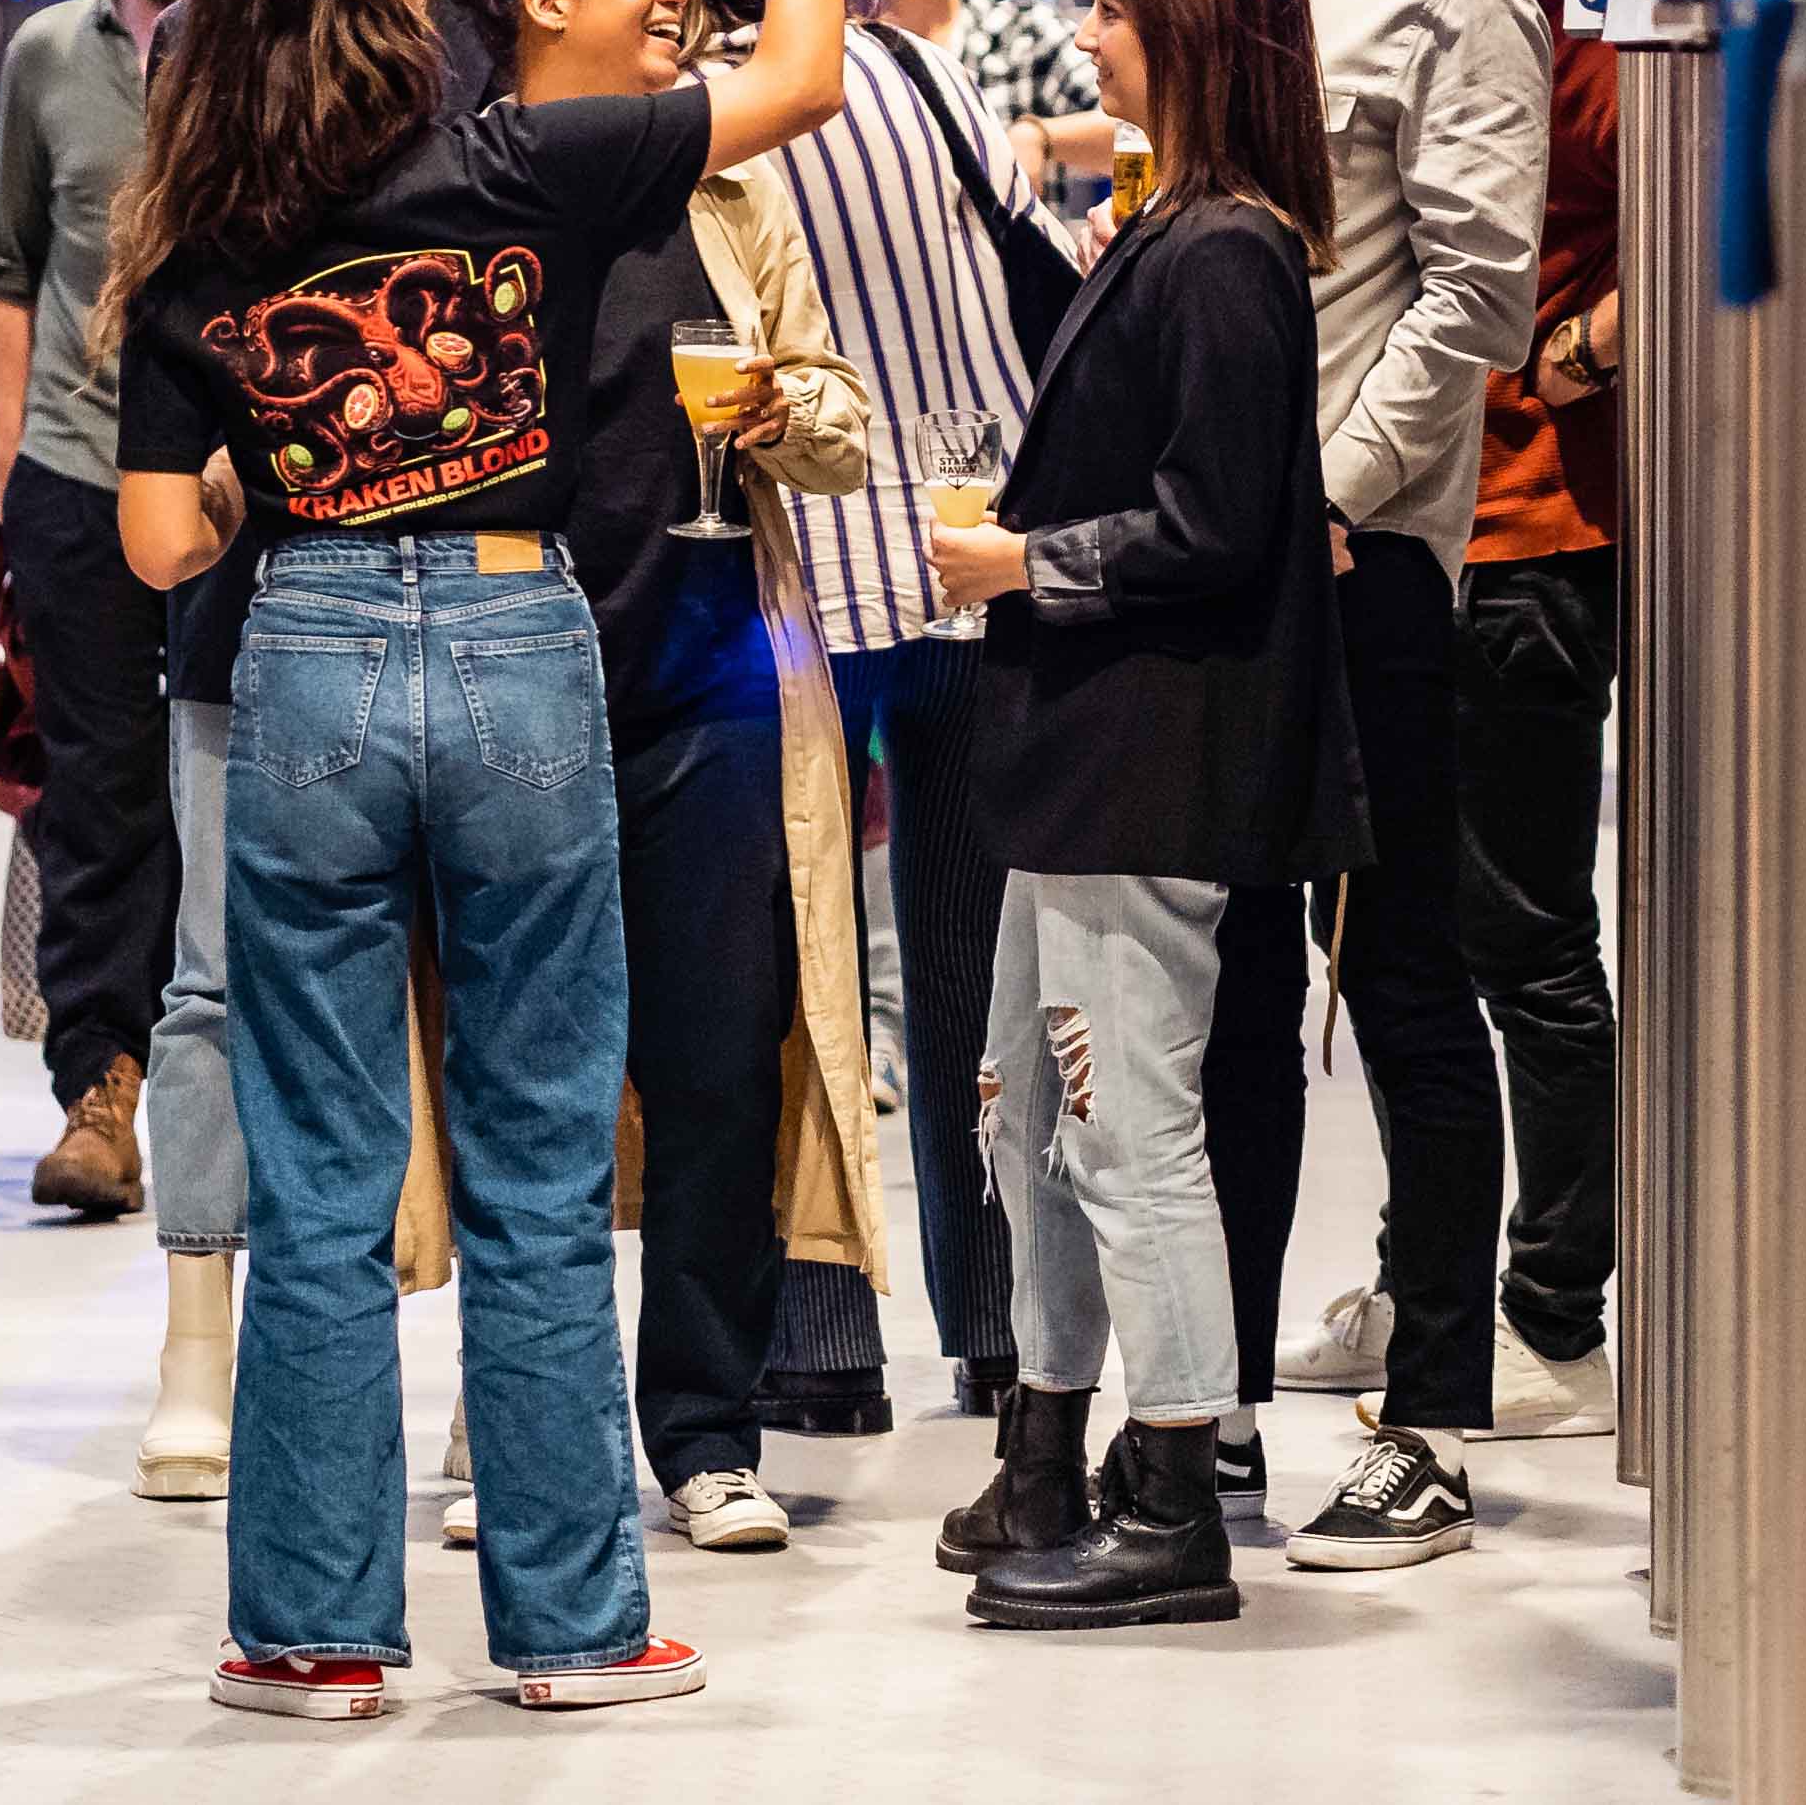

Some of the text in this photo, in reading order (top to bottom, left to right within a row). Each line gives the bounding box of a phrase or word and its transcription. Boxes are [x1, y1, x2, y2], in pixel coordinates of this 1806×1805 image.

[289, 428, 550, 520] KRAKEN BLOND
[392, 499, 417, 513] WITH
[416, 493, 448, 507] BLOOD
[482, 475, 500, 488] AND
[517, 458, 547, 475] BERRY
[939, 466, 977, 474] HAVEN
